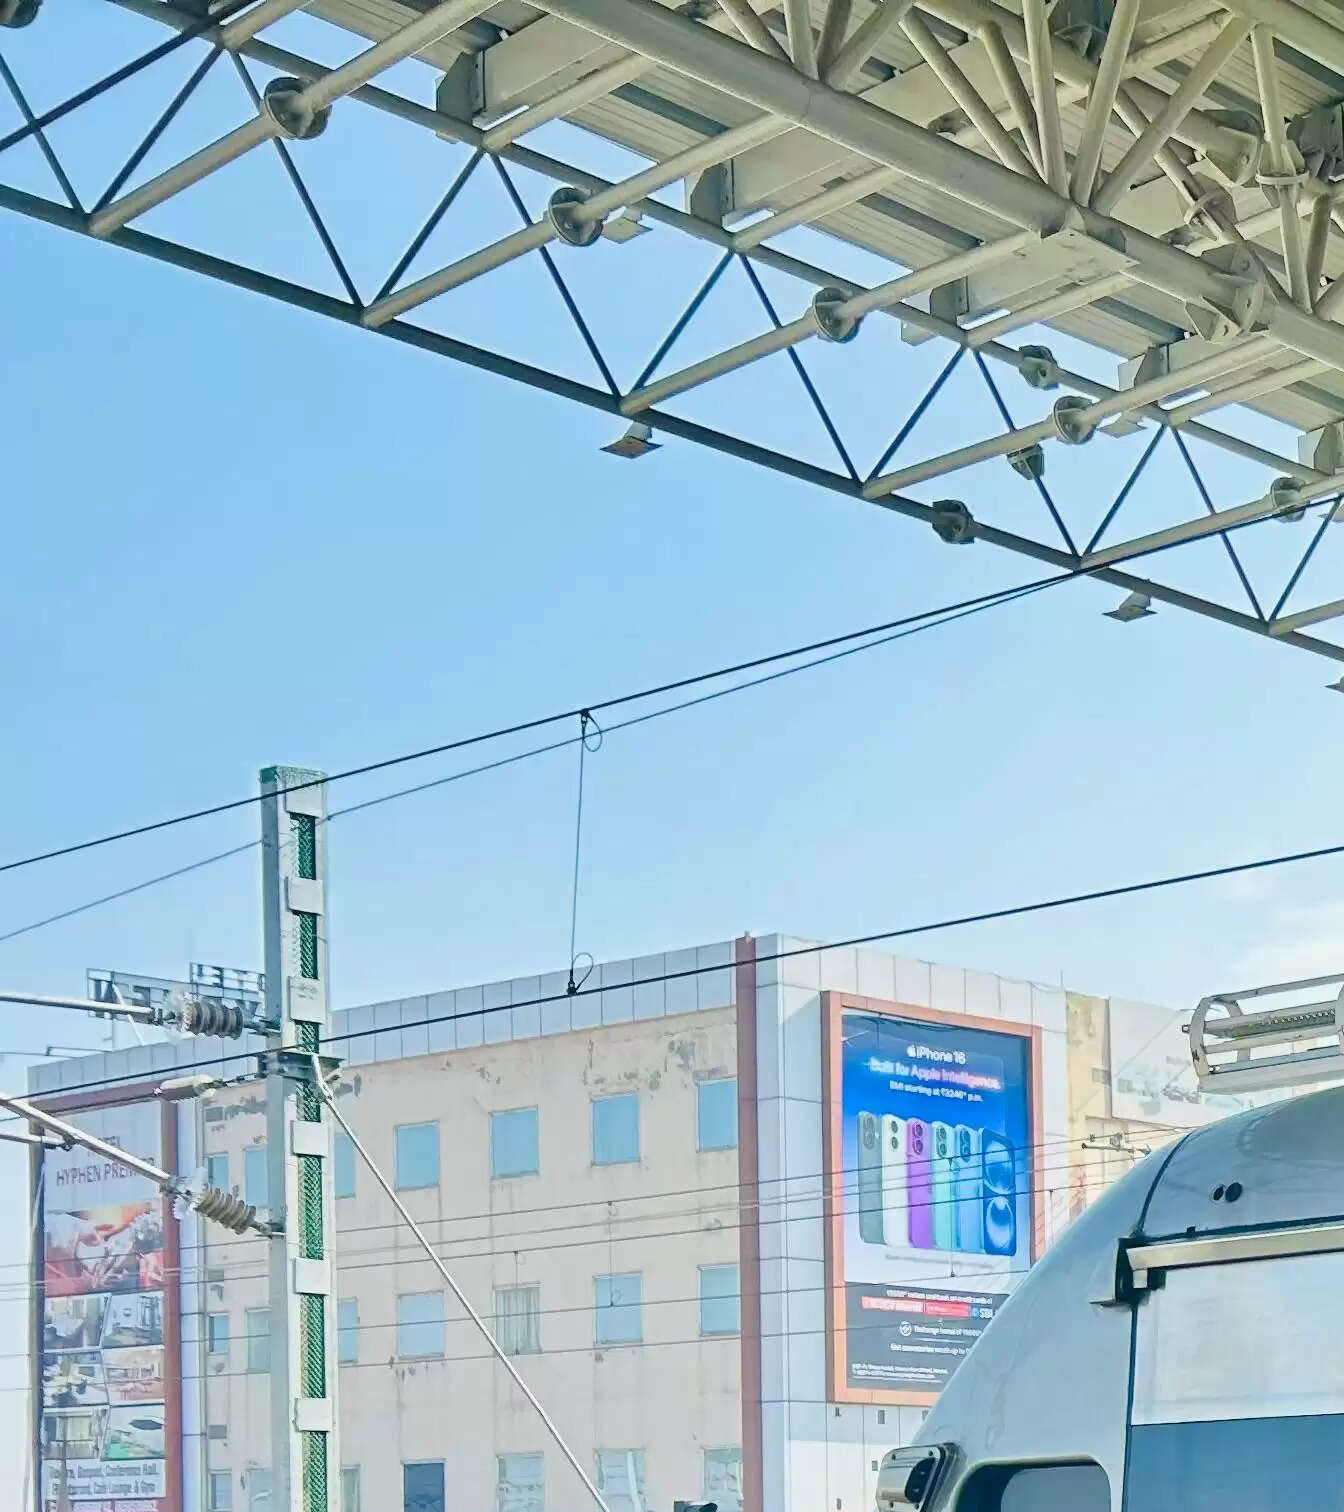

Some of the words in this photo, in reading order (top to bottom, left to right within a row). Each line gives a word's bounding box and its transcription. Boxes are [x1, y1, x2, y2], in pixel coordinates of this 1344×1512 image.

[916, 1045, 952, 1063] iPhone
[911, 1065, 940, 1081] Apple
[56, 1164, 102, 1186] HYPHEN
